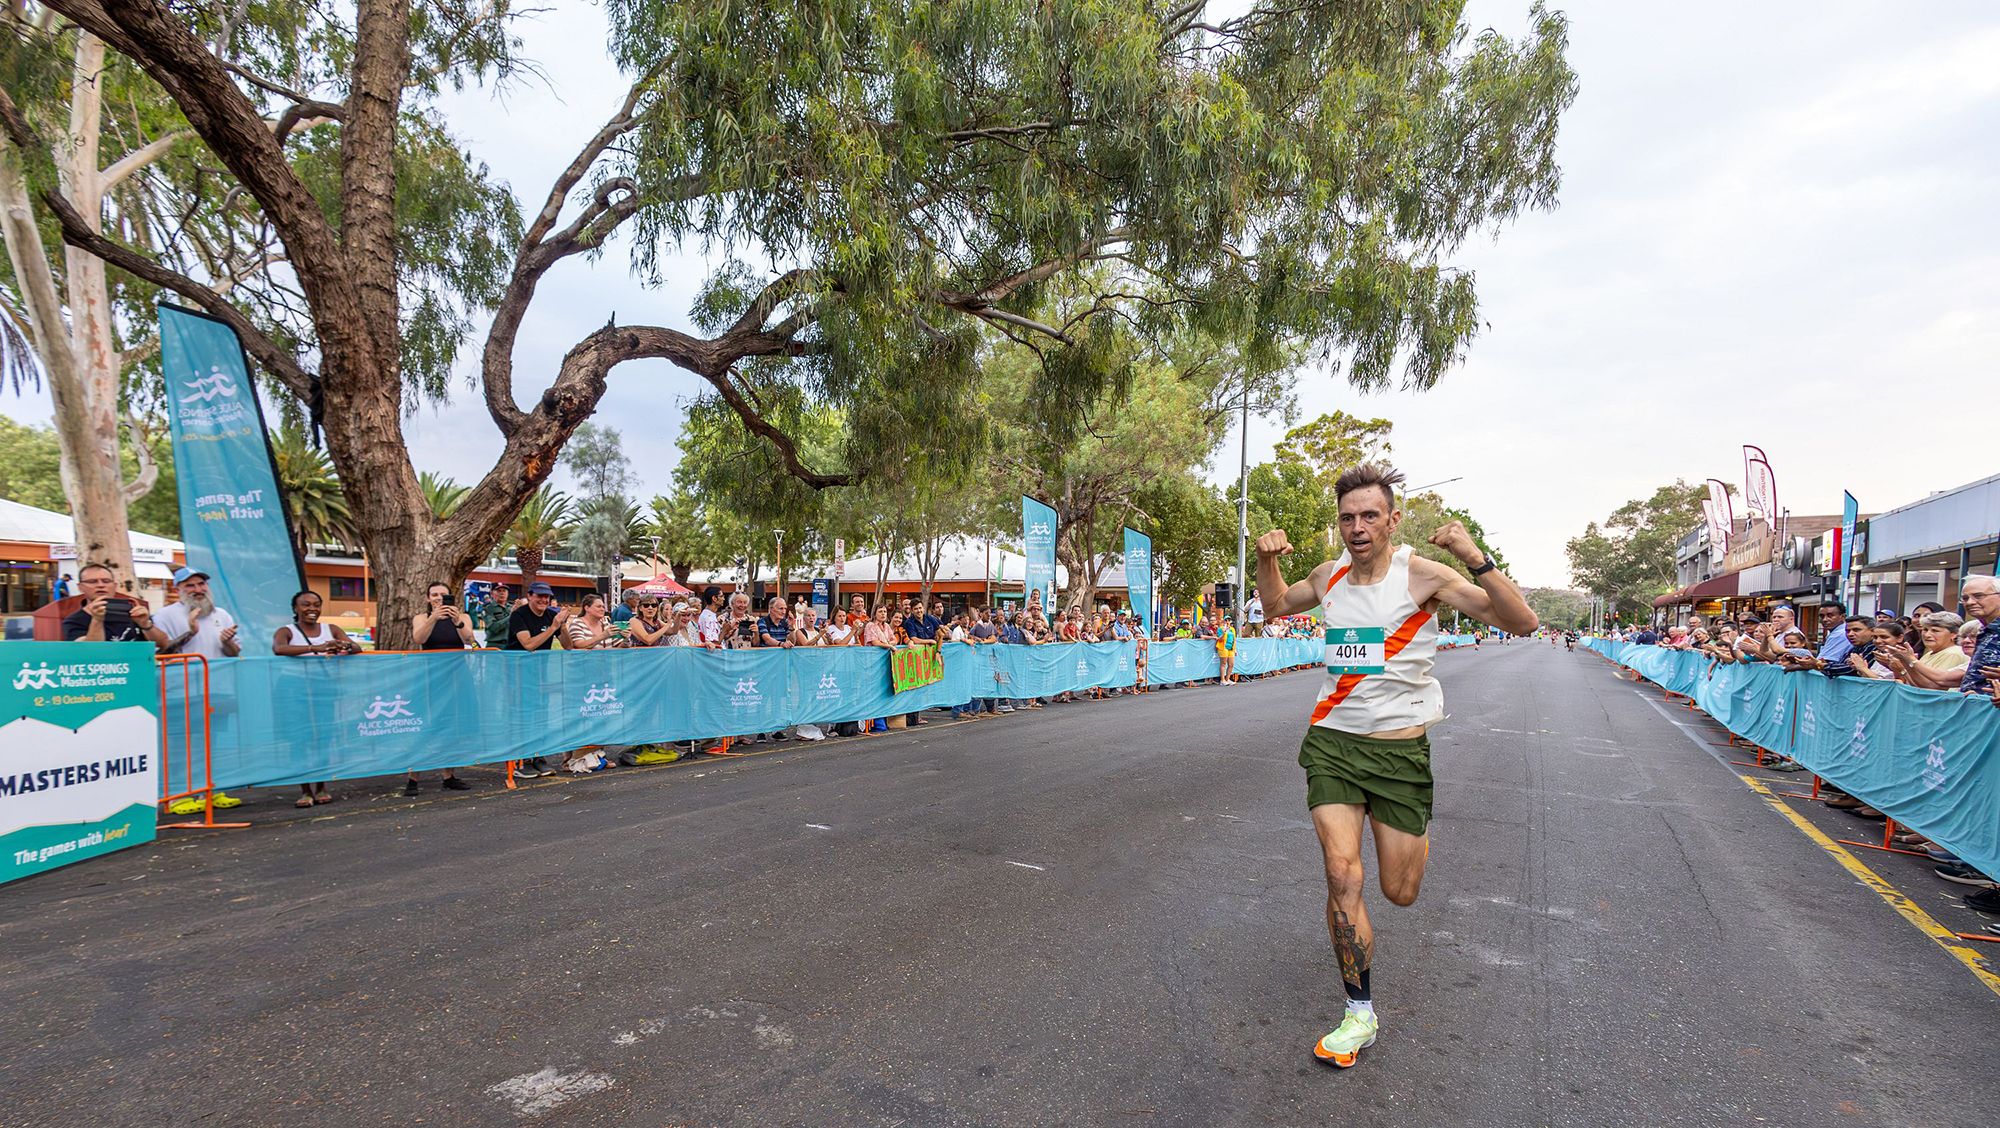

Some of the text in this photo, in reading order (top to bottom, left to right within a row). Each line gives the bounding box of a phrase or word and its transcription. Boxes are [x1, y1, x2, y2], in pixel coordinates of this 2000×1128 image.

[1336, 644, 1367, 659] 4014
[57, 663, 130, 677] ALICE SPRINGS
[61, 675, 128, 688] Masters Games
[34, 697, 45, 706] 12
[62, 694, 93, 704] October
[94, 692, 115, 702] 2024
[357, 717, 423, 732] ALICE SPRINGS
[360, 725, 420, 737] Masters Games
[0, 754, 147, 798] MASTERS MILE
[14, 849, 38, 865] The
[40, 839, 77, 863] games
[78, 831, 103, 849] with
